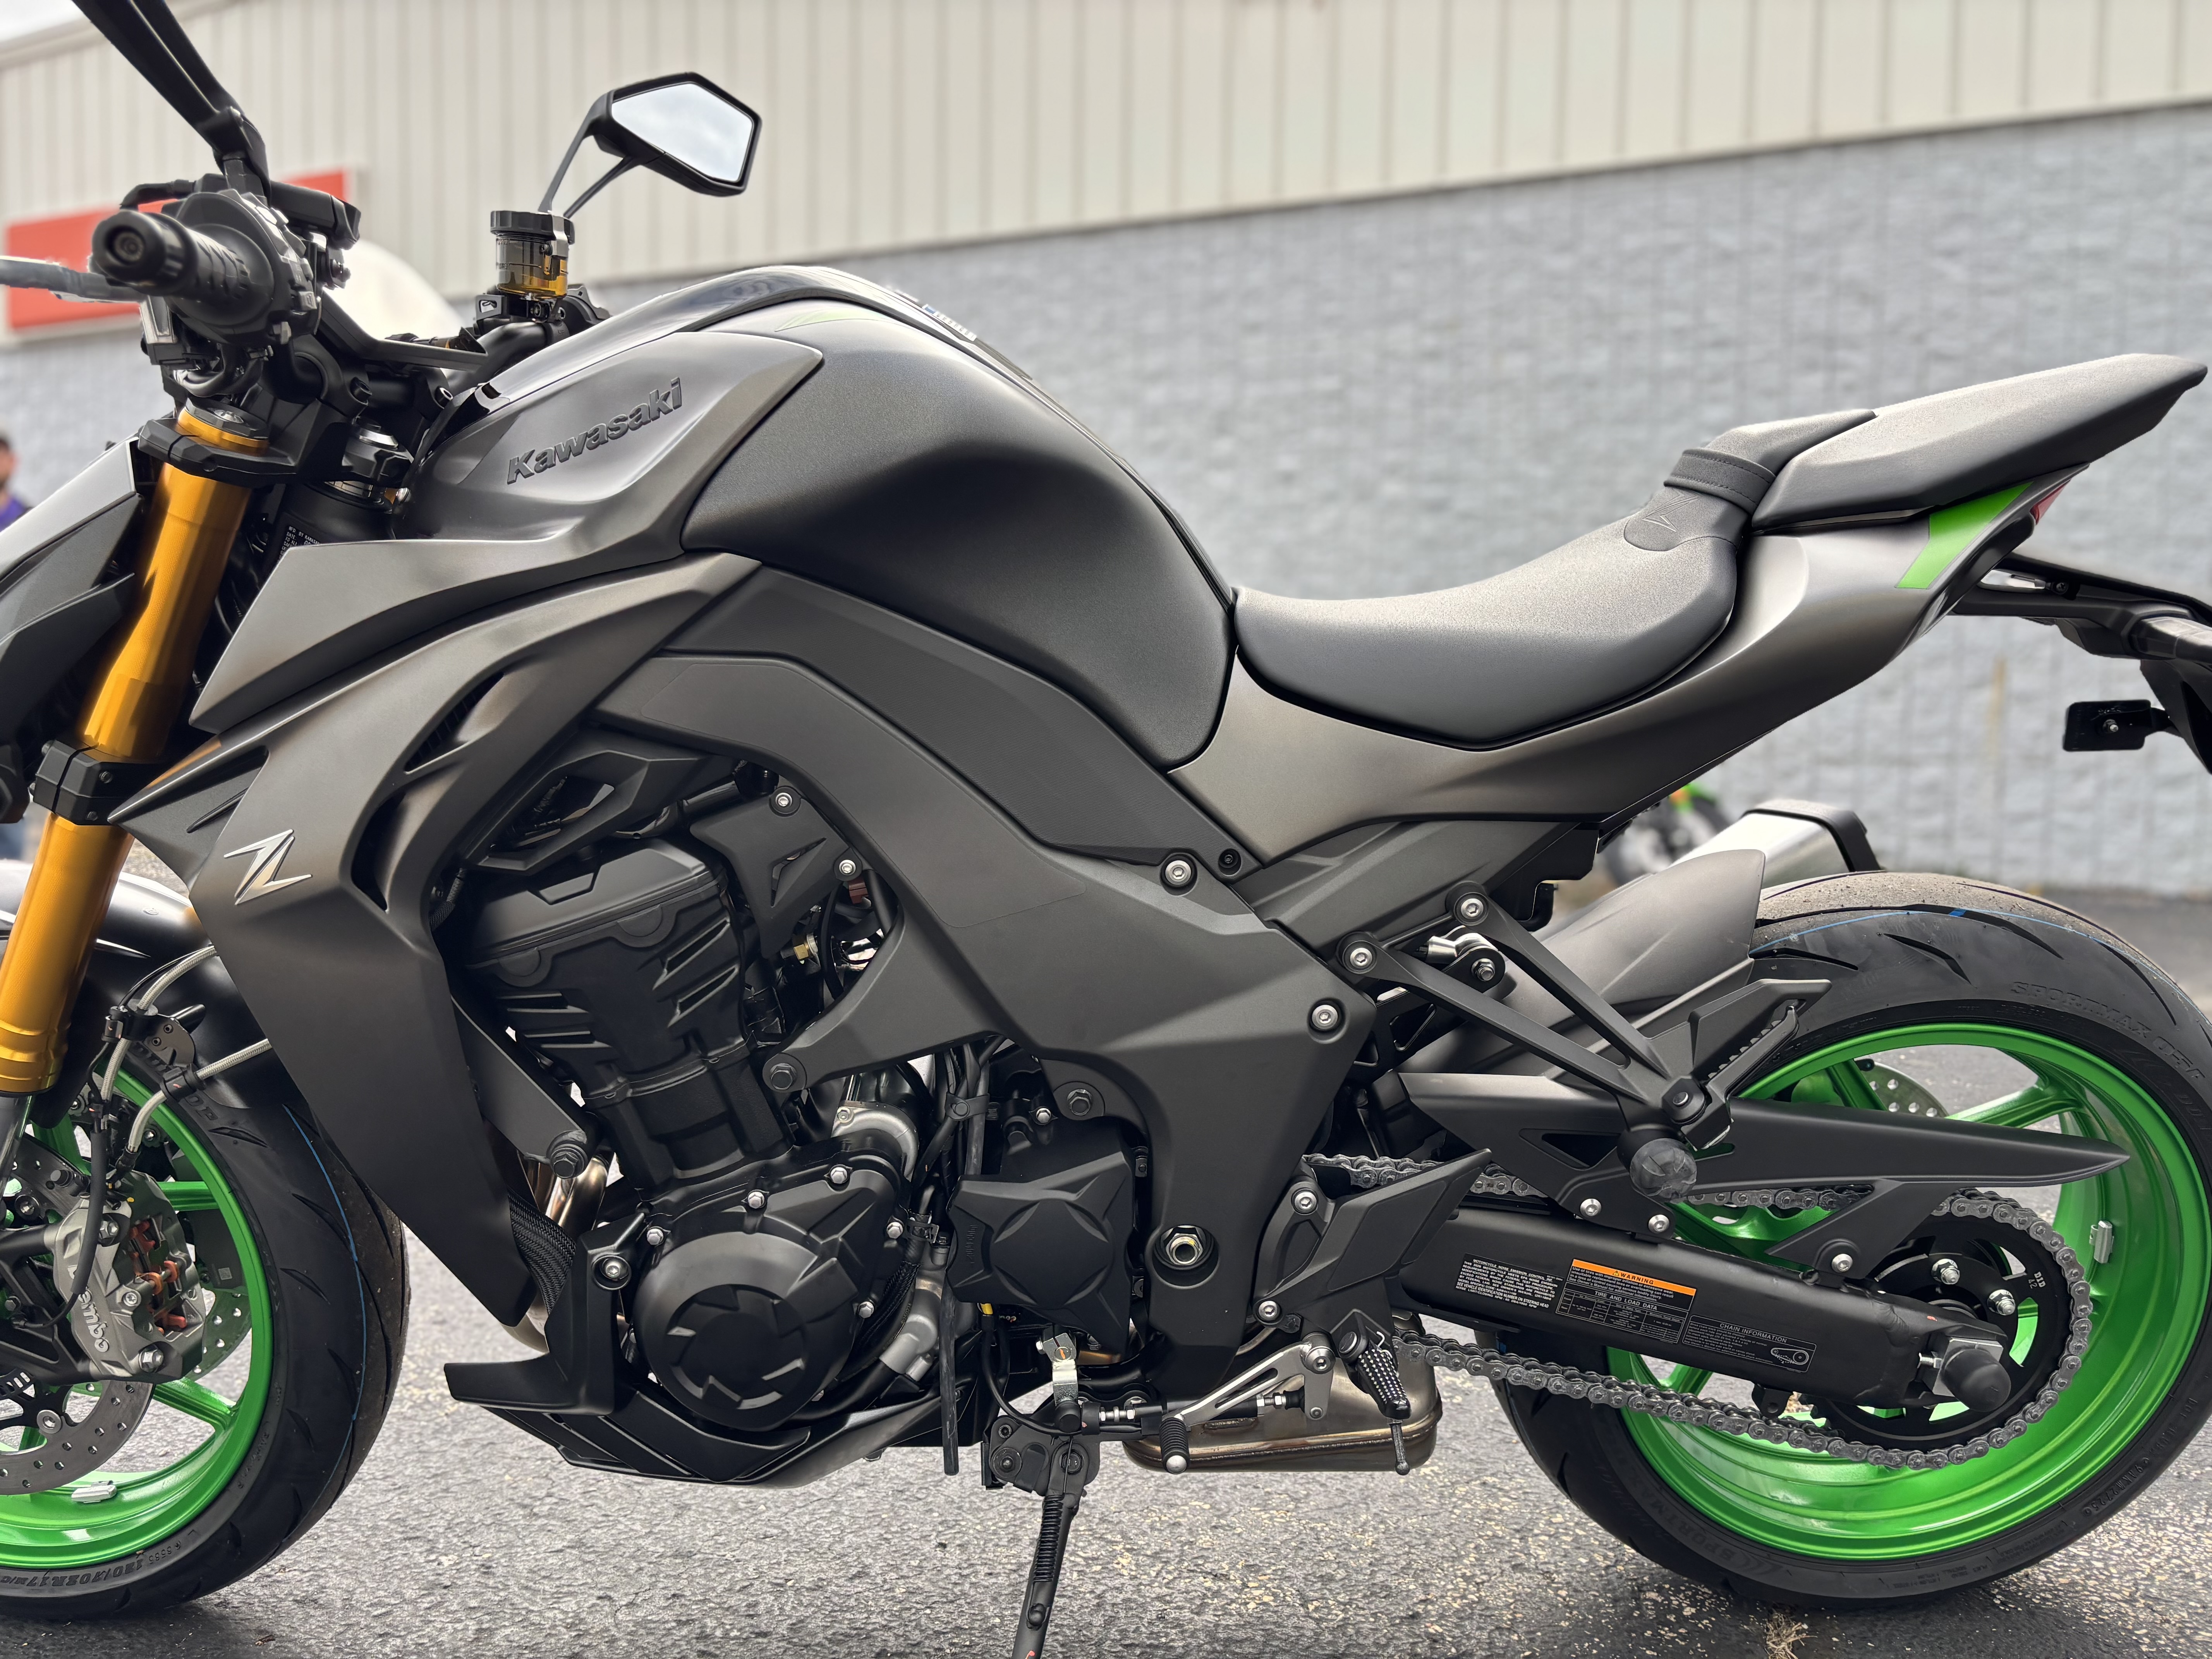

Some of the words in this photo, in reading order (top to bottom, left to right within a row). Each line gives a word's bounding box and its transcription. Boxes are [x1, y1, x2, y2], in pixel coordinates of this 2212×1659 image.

[507, 377, 683, 484] Kawasaki
[129, 1039, 219, 1121] DUOP
[1620, 1272, 1654, 1285] WARNING
[2027, 1278, 2038, 1290] 42
[2034, 1271, 2047, 1289] DID
[1477, 1286, 1503, 1297] IDENTIFICATION
[67, 1265, 110, 1352] embo
[1623, 1298, 1640, 1306] LOAD
[1642, 1302, 1658, 1310] DATA
[1719, 1322, 1740, 1332] CHAIN
[1741, 1328, 1787, 1343] INFORMATION
